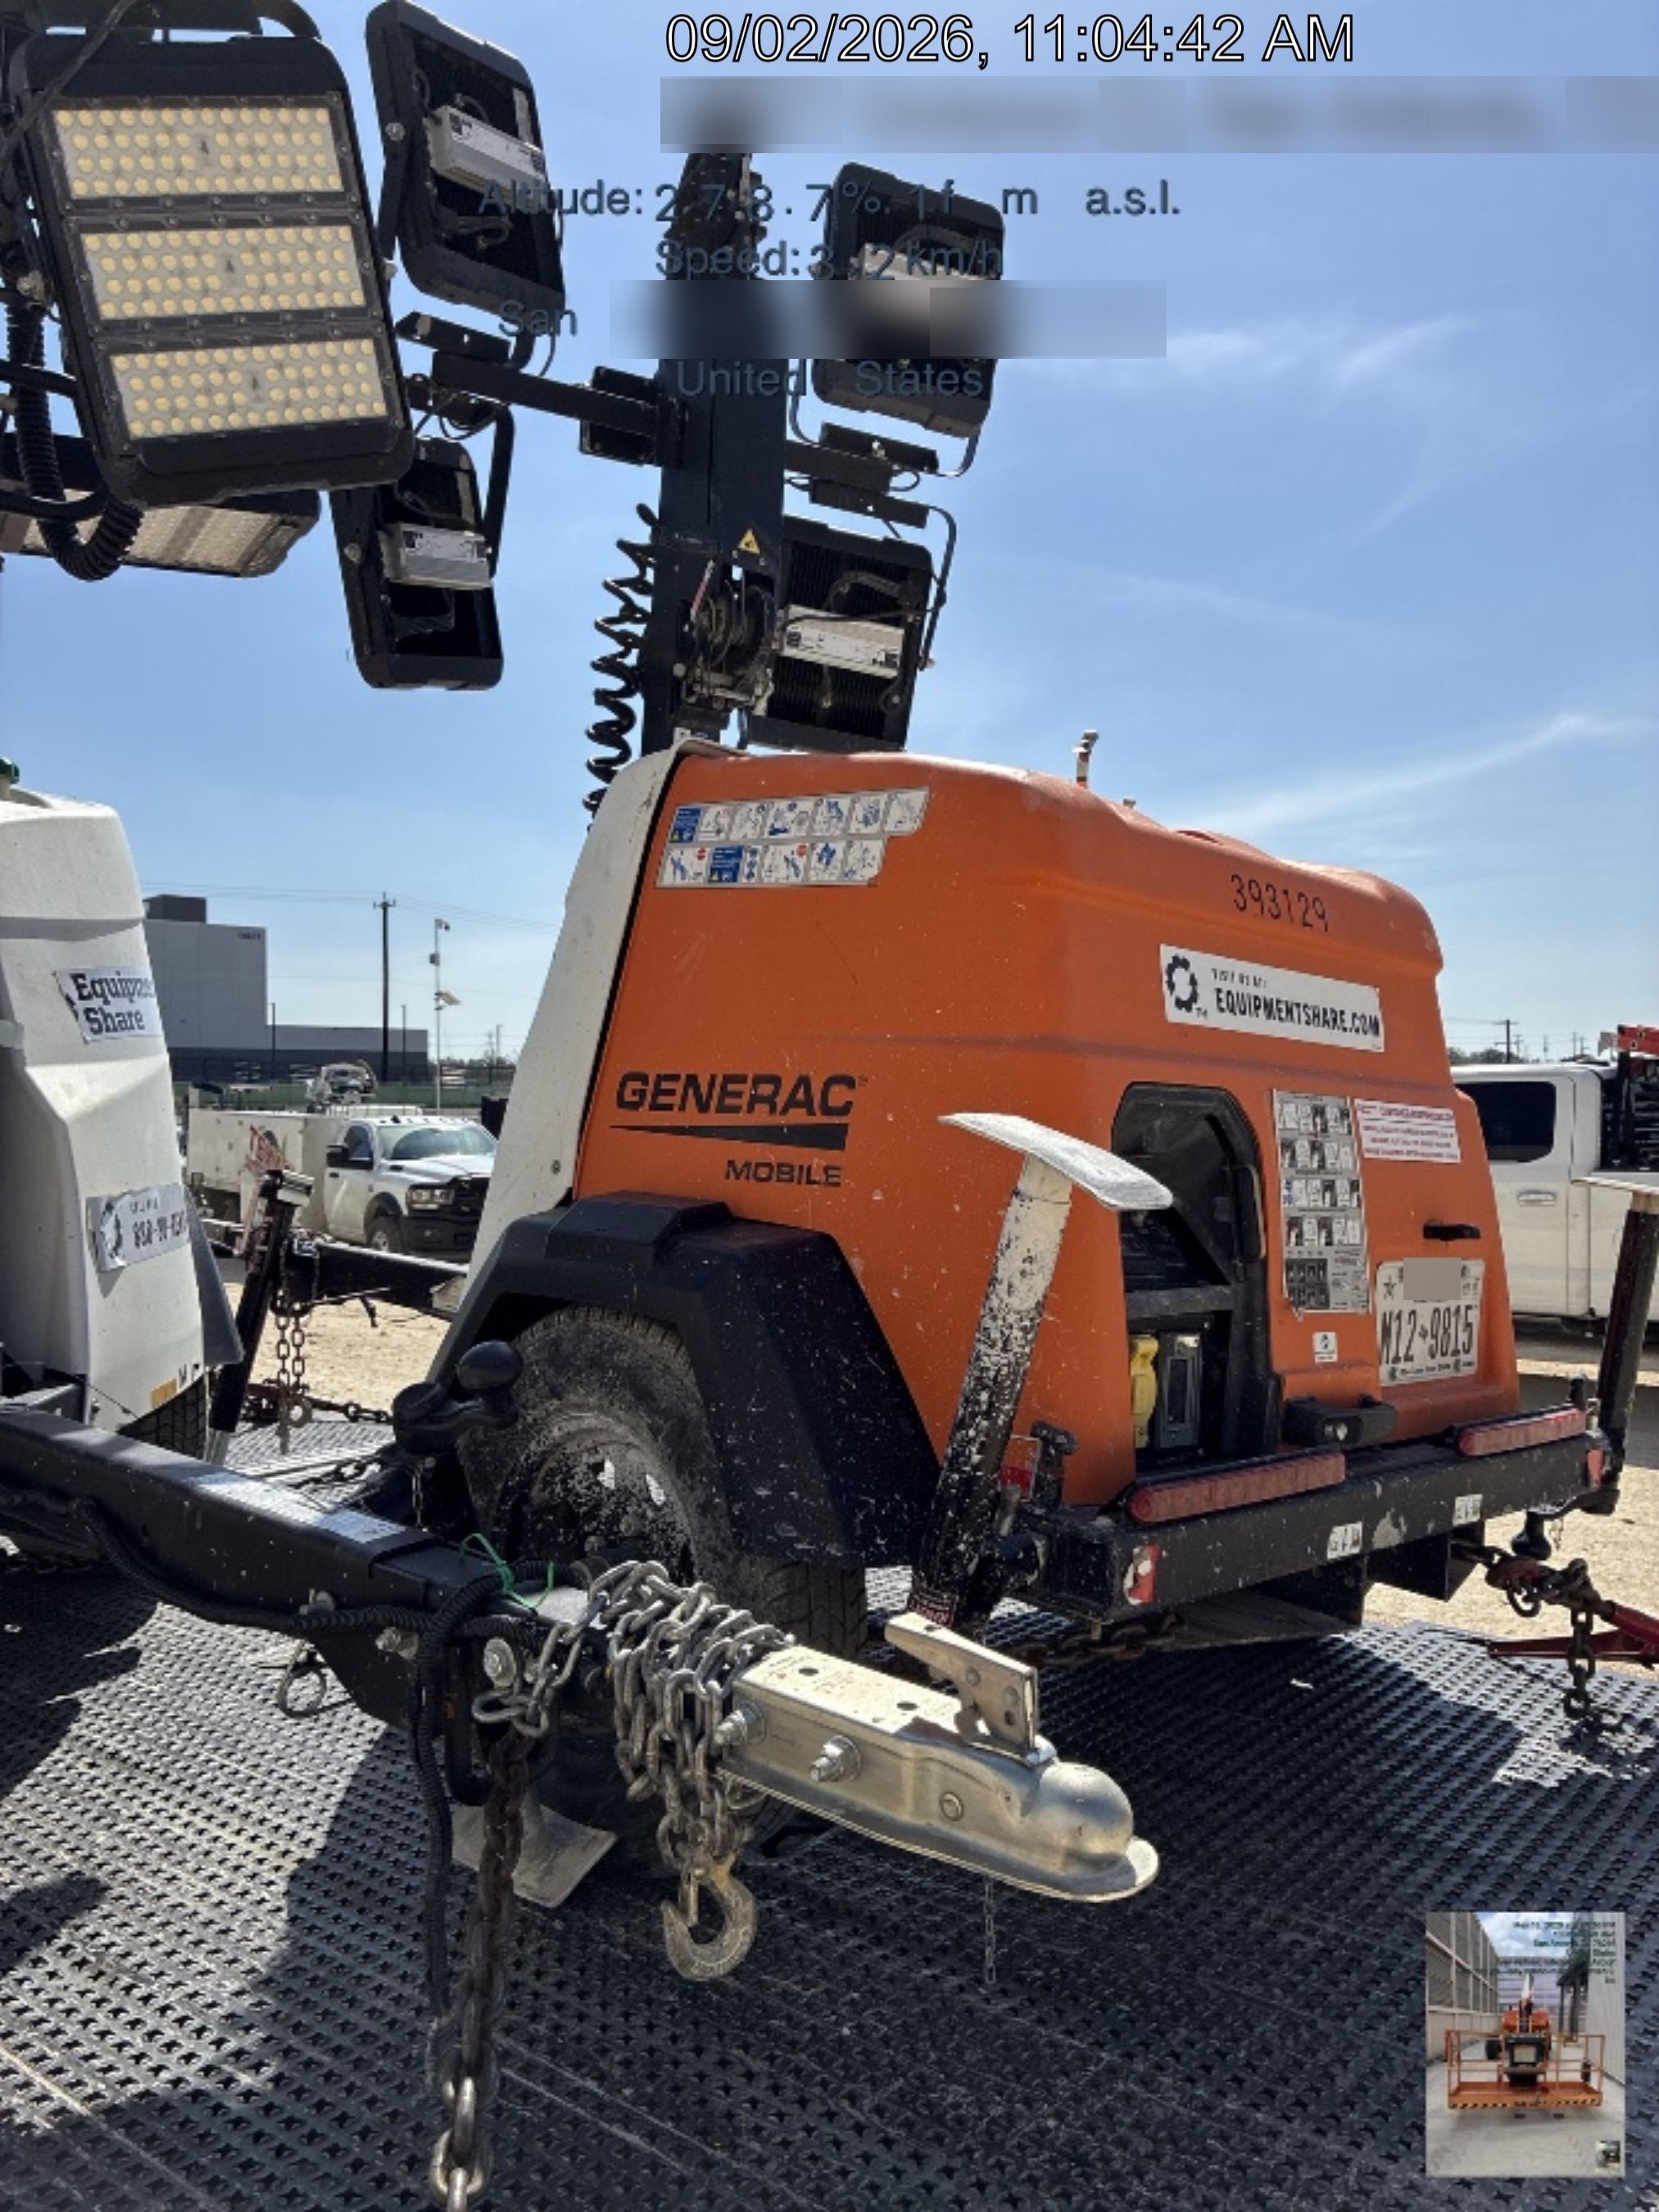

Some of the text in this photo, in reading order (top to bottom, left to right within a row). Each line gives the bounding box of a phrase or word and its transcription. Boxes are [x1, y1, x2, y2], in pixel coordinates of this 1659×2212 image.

[1231, 873, 1329, 932] 393129
[83, 1007, 145, 1036] Share
[1215, 987, 1380, 1037] EQUIPMENTSHARE.COM
[616, 1072, 856, 1117] GENERAC
[725, 1160, 841, 1187] MOBILE
